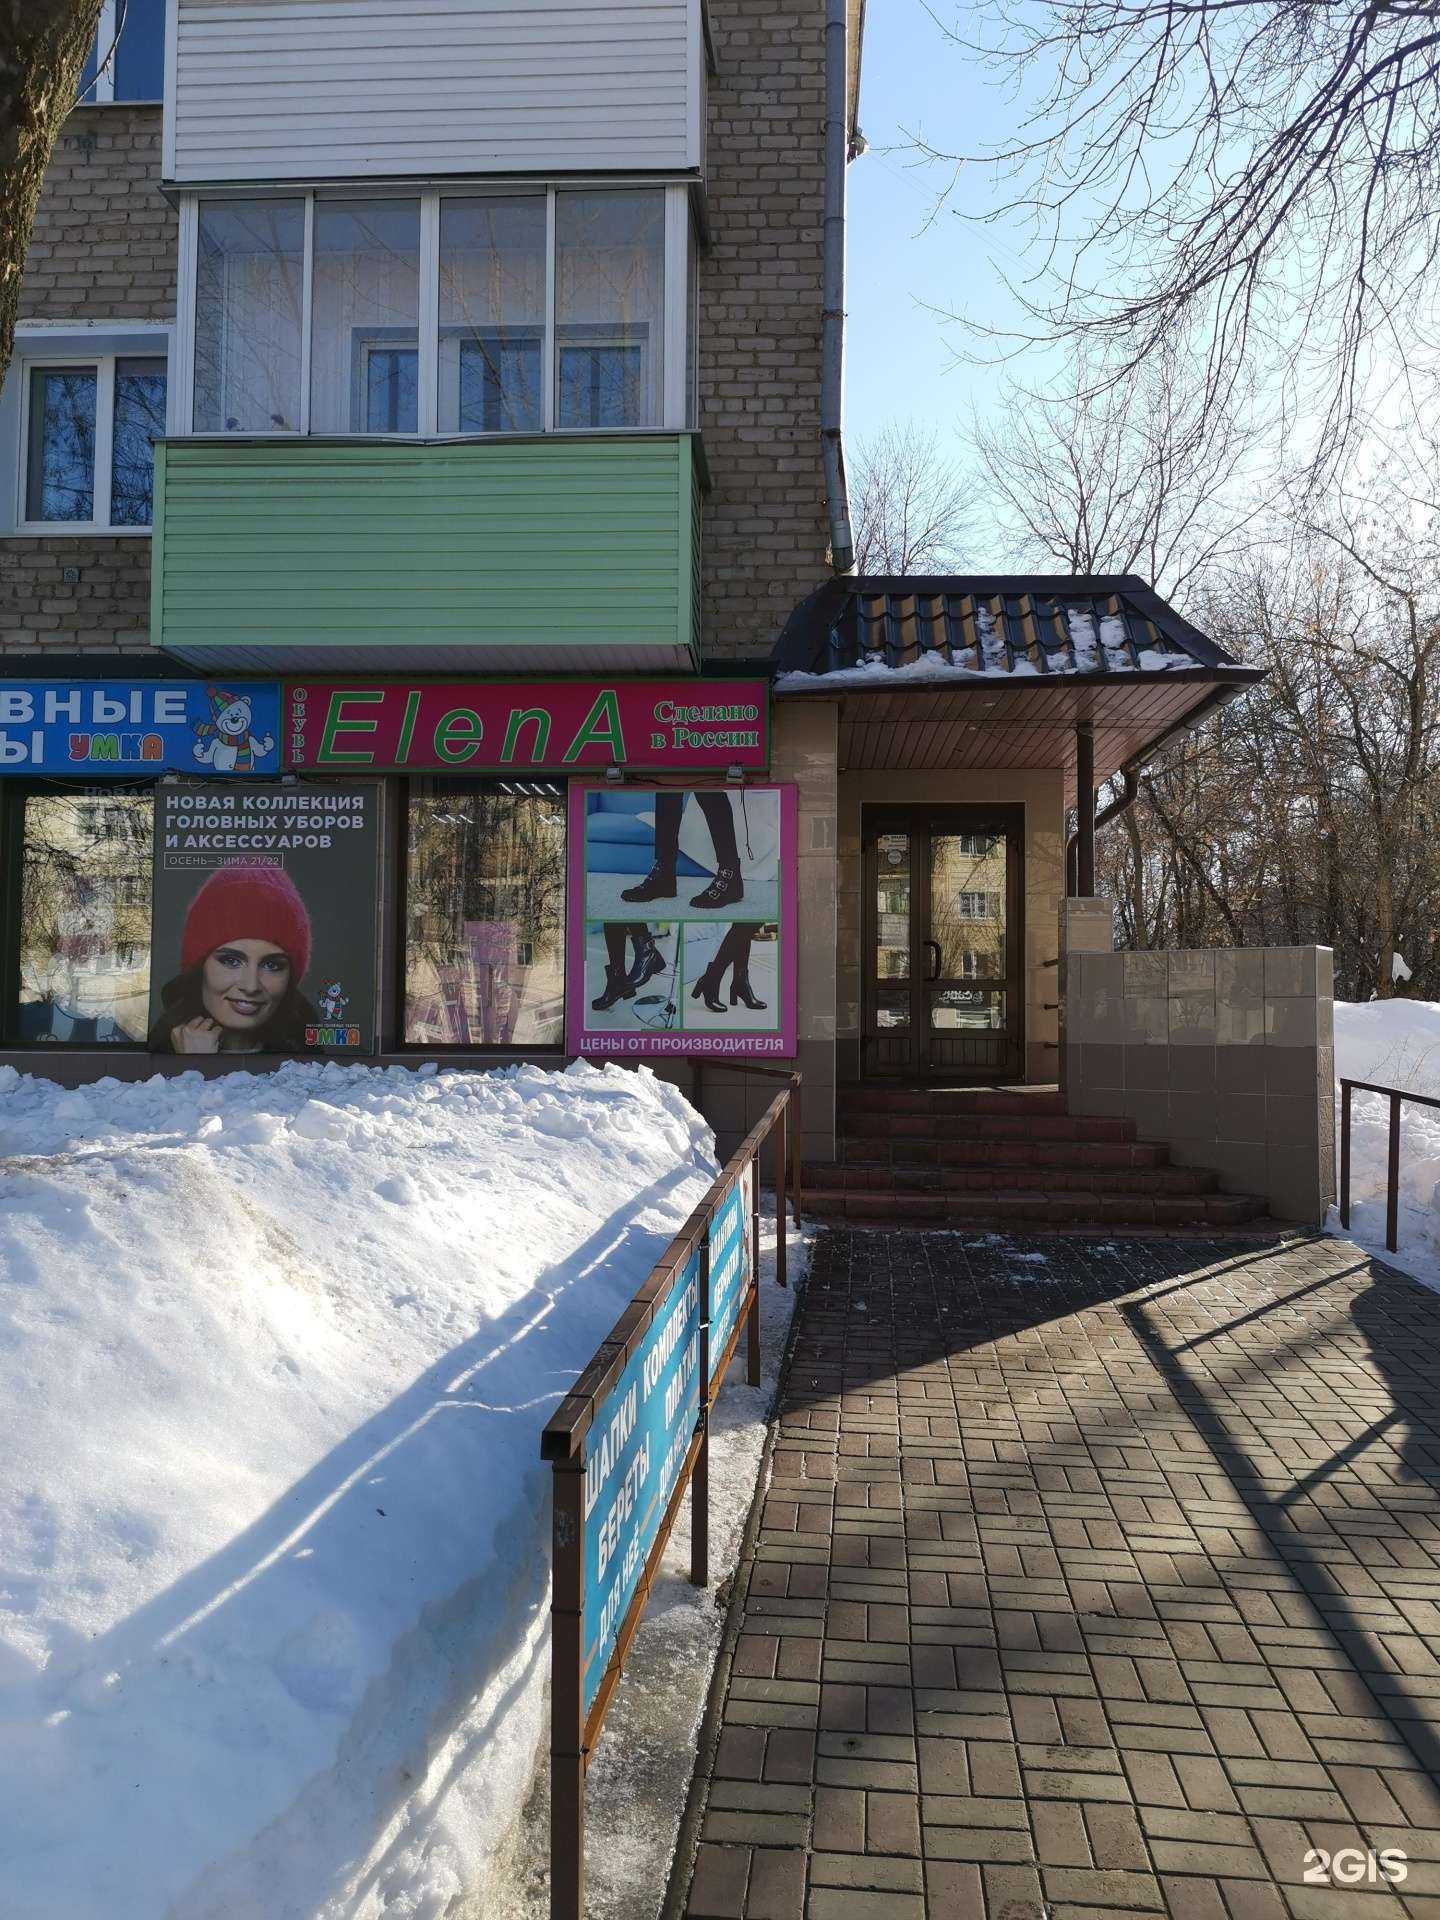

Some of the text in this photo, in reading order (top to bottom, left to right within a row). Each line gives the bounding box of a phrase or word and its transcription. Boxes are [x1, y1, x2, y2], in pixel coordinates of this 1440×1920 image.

[0, 690, 187, 724] ВНЫЕ
[653, 700, 759, 725] Сделано
[292, 688, 308, 763] ОБУВЬ
[317, 689, 628, 764] ElenA
[650, 727, 759, 749] в России
[69, 733, 164, 761] УМКА
[166, 796, 364, 812] НОВАЯ КОЛЛЕКЦИЯ
[166, 815, 364, 829] ГОЛОВНЫХ УБОРОВ
[165, 835, 332, 848] И АКСЕССУАРОВ
[580, 1037, 784, 1052] ЦЕНЫ ОТ ПРОИЗВОДИТЕЛЯ
[584, 1271, 698, 1523] ШАПКИ КОМПЛЕКТЫ
[598, 1330, 698, 1585] БЕРЕТЫ ПЛАТКИ
[599, 1519, 640, 1658] ДЛЯ НЕЁ
